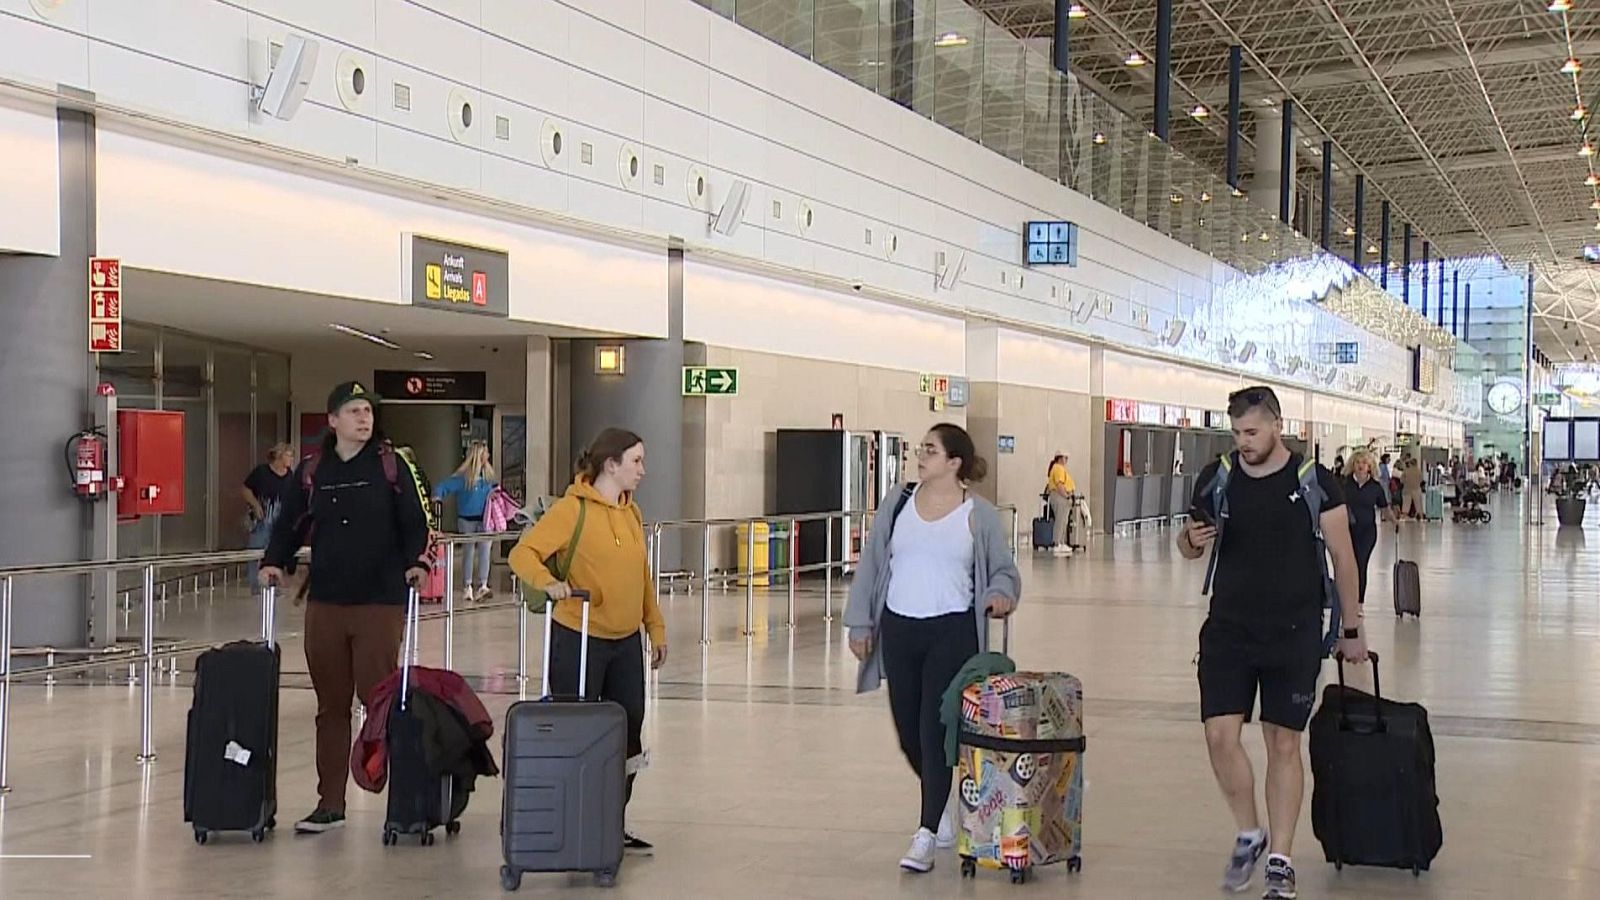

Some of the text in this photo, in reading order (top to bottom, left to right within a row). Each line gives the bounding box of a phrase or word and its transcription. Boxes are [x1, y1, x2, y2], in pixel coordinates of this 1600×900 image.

[443, 252, 465, 269] Ankunft
[443, 269, 463, 285] Arrivals
[443, 284, 470, 303] Llegadas
[475, 278, 483, 299] A
